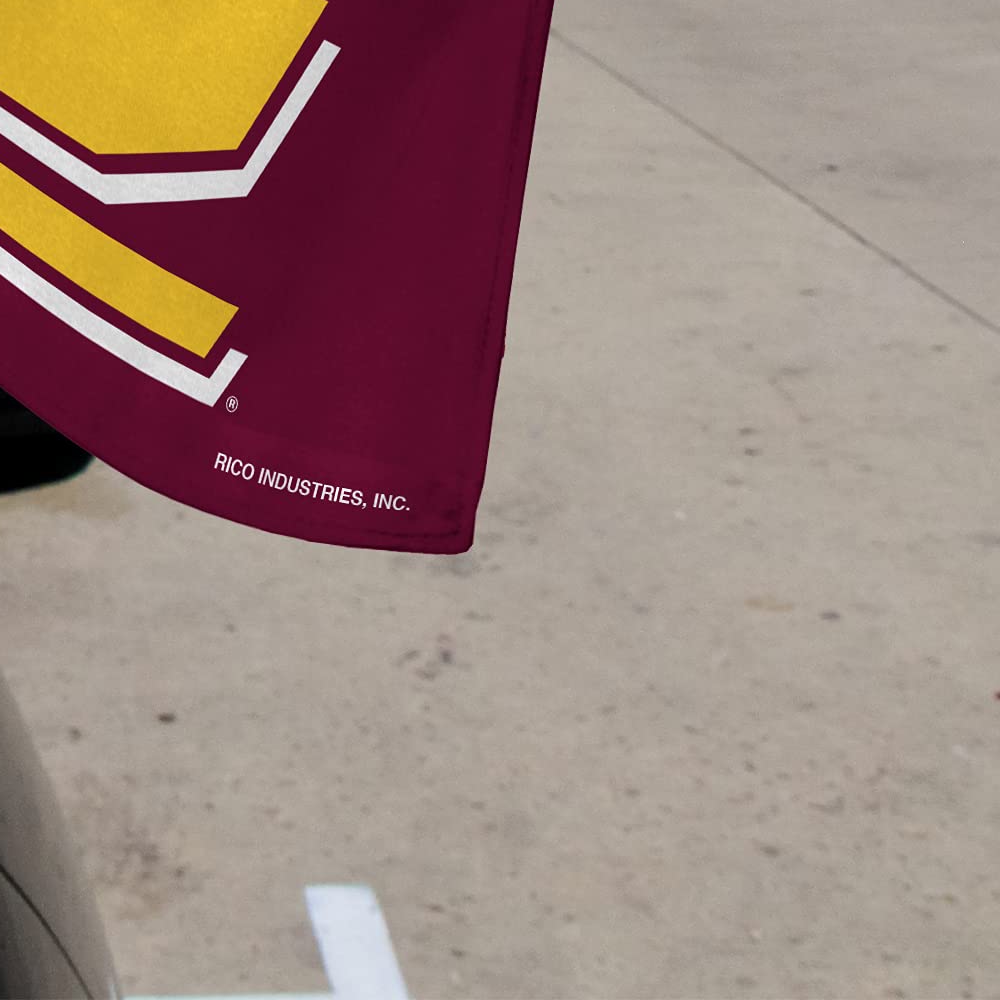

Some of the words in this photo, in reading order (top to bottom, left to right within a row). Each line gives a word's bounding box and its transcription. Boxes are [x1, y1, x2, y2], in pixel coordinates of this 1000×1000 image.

[213, 452, 255, 481] RICO
[257, 467, 367, 510] INDUSTRIES,
[372, 492, 410, 511] INC.
